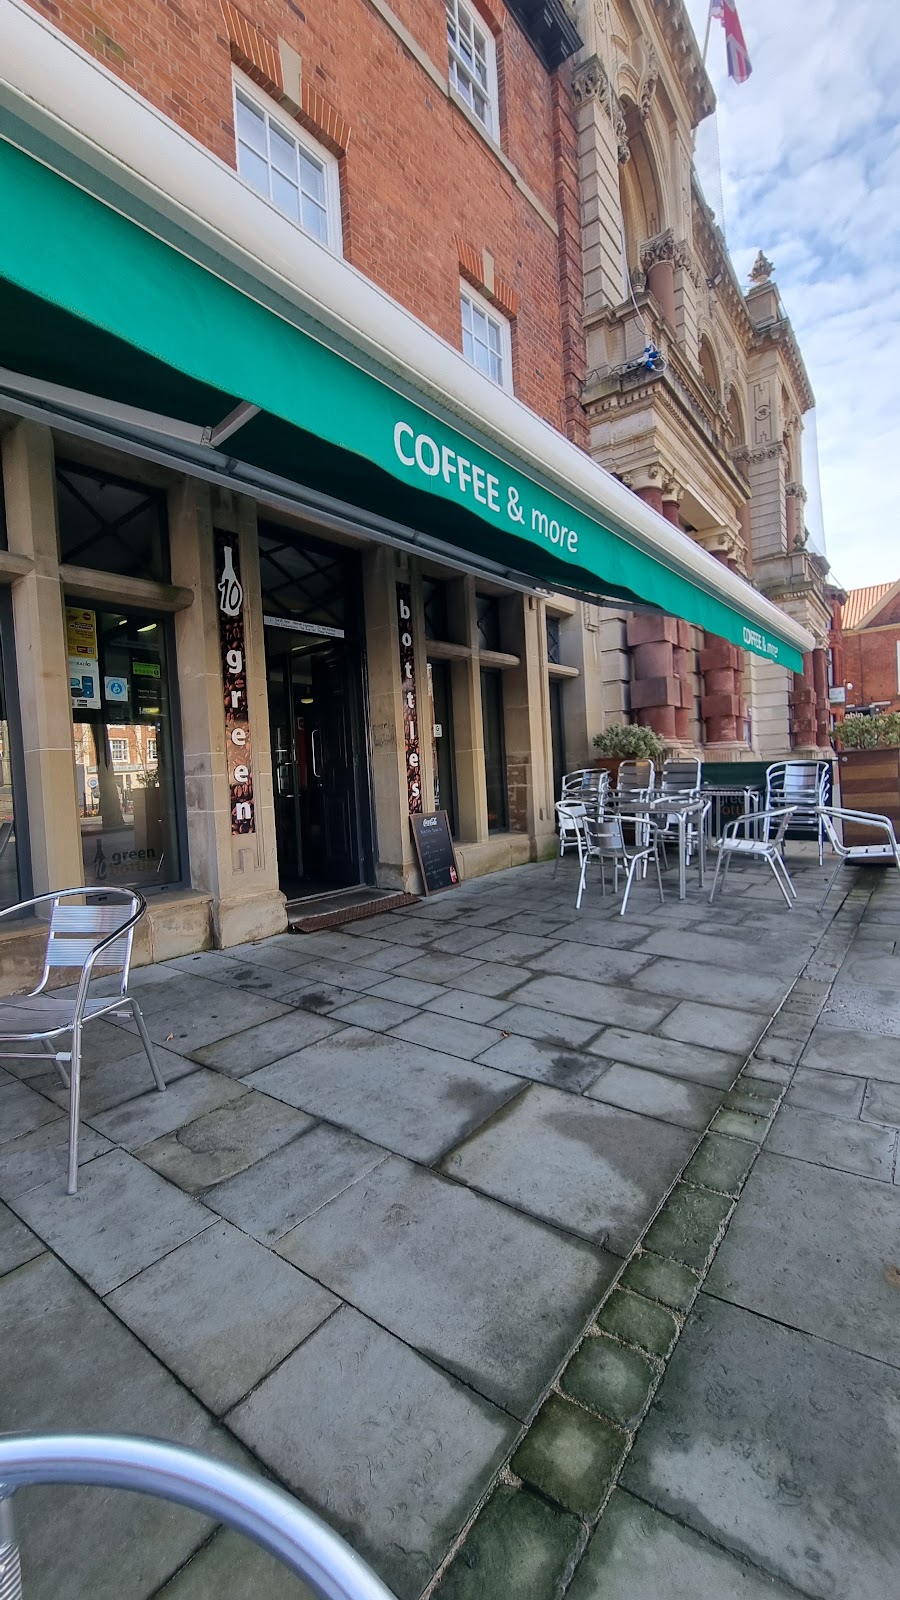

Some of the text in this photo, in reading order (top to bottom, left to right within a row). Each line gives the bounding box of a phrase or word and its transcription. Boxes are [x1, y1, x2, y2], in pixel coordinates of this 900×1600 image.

[393, 421, 578, 553] COFFEE & more
[219, 578, 241, 611] 10
[111, 848, 156, 866] green
